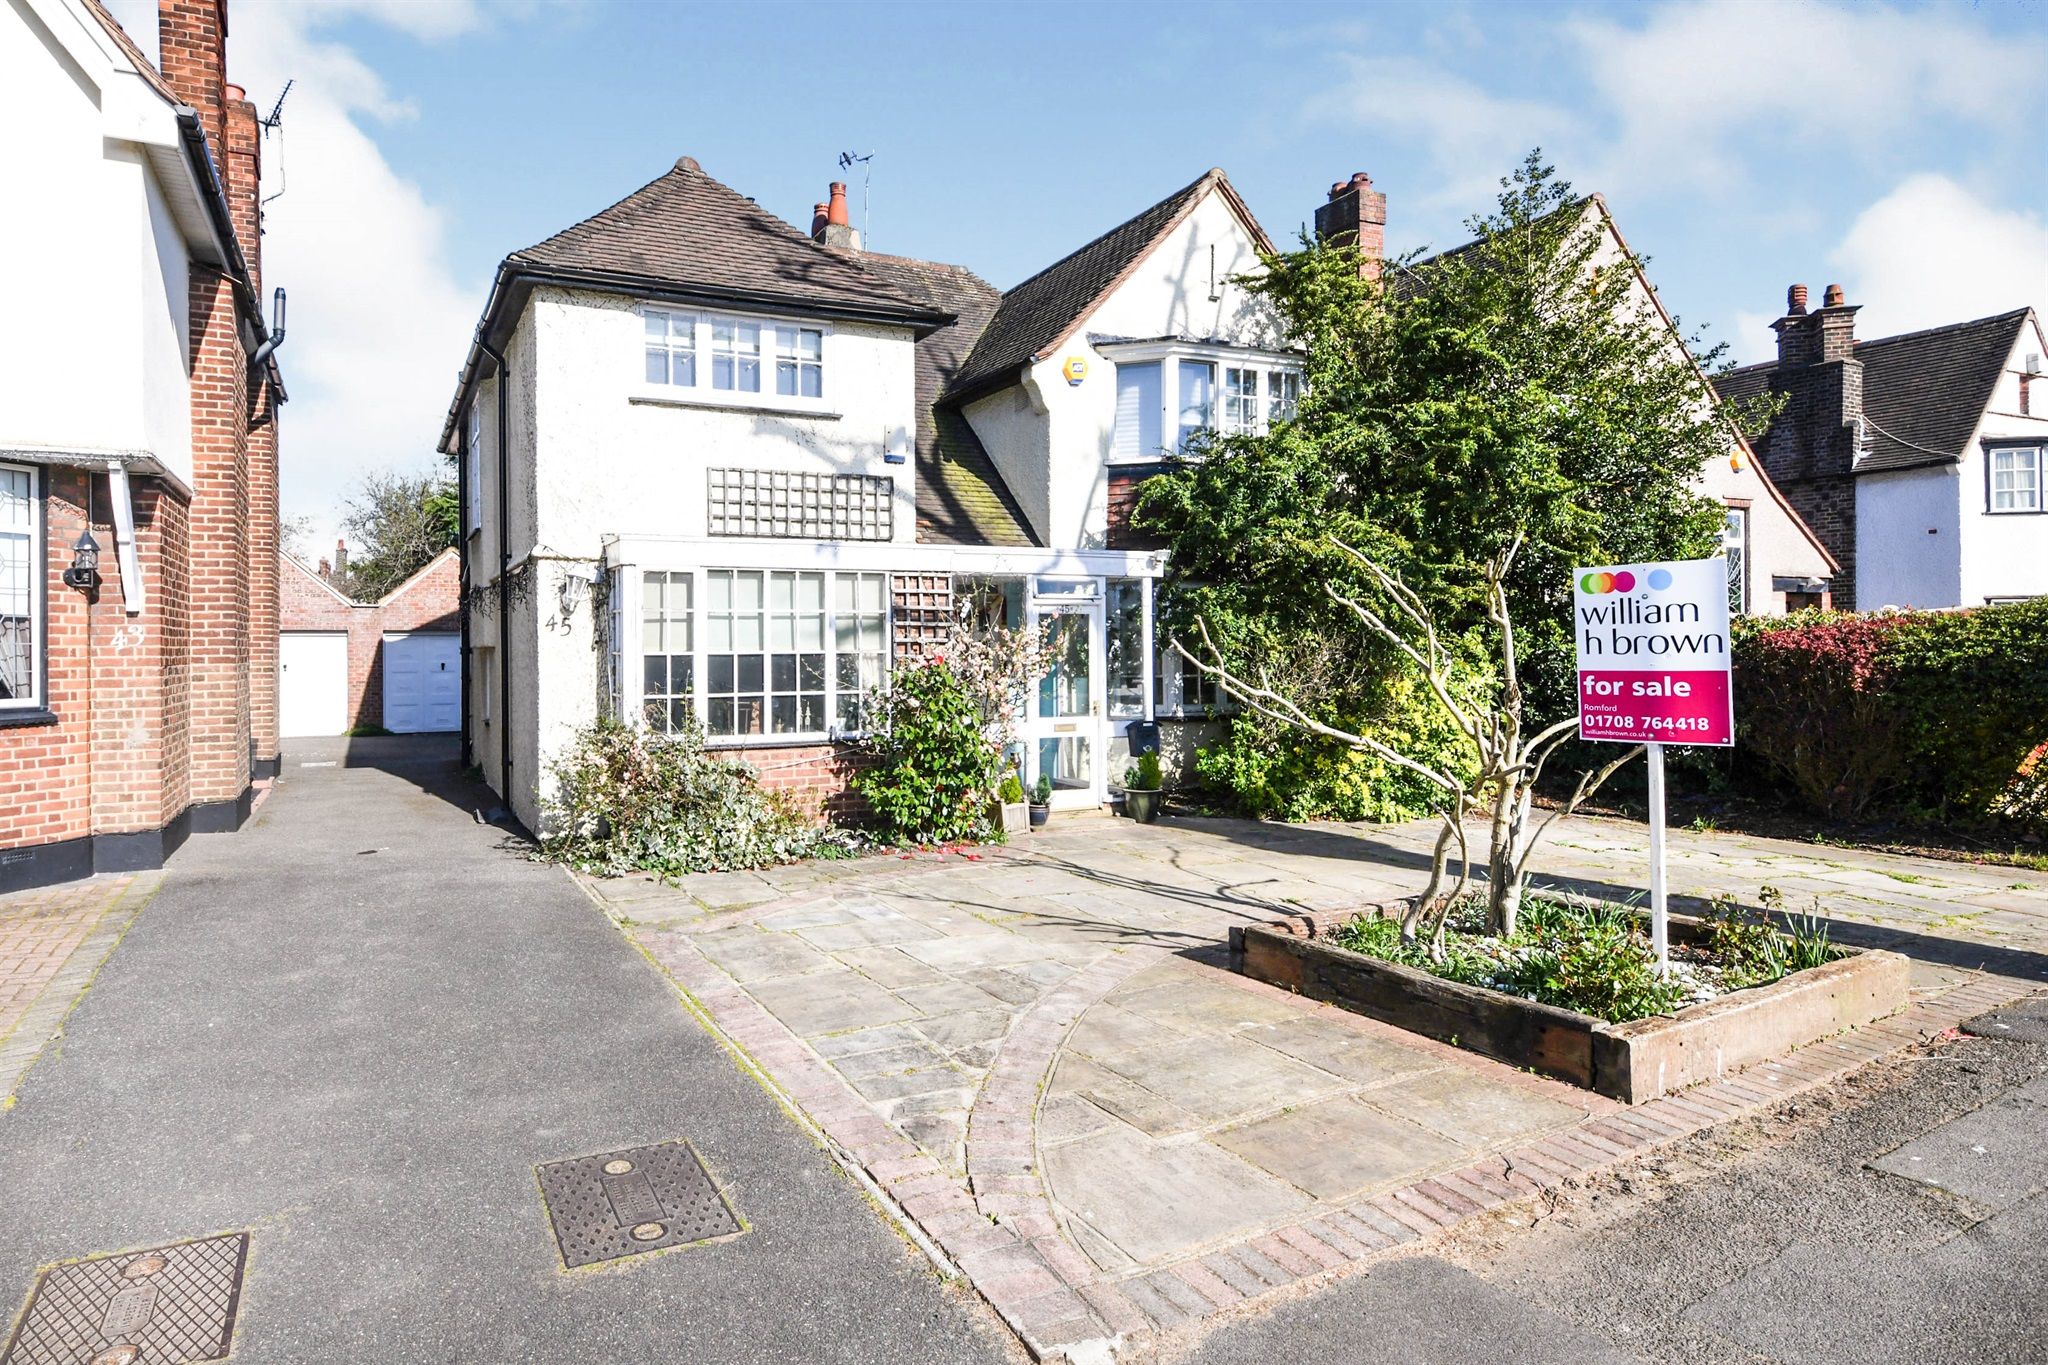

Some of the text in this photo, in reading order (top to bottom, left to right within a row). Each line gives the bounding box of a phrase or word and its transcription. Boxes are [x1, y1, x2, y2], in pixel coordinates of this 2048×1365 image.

[1581, 597, 1699, 625] william
[545, 613, 572, 637] 45
[110, 624, 145, 651] 43
[1585, 628, 1723, 655] h brown
[1583, 675, 1691, 697] for sale
[1584, 703, 1618, 712] Romford
[1585, 714, 1710, 731] 01708 764418
[1585, 729, 1646, 738] williamhbrown.co.uk
